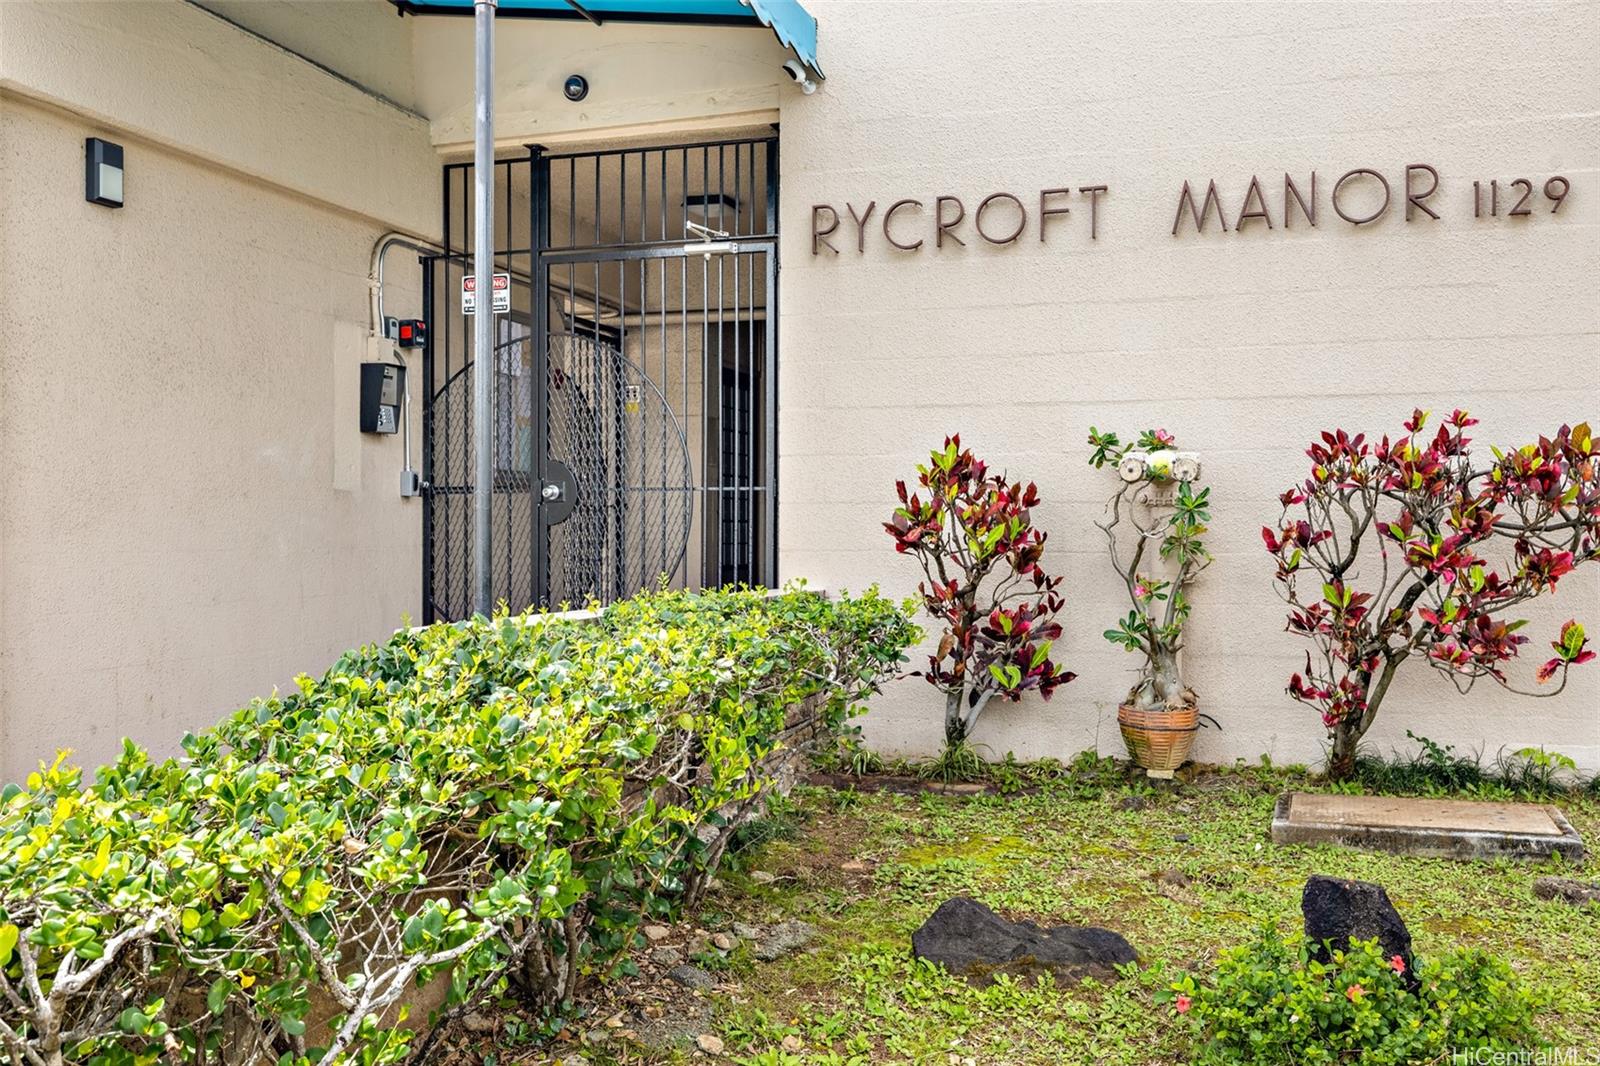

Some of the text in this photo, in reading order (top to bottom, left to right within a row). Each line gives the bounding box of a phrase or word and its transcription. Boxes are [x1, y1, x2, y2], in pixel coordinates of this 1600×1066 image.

[811, 163, 1570, 256] RYCROFT MANOR 1129
